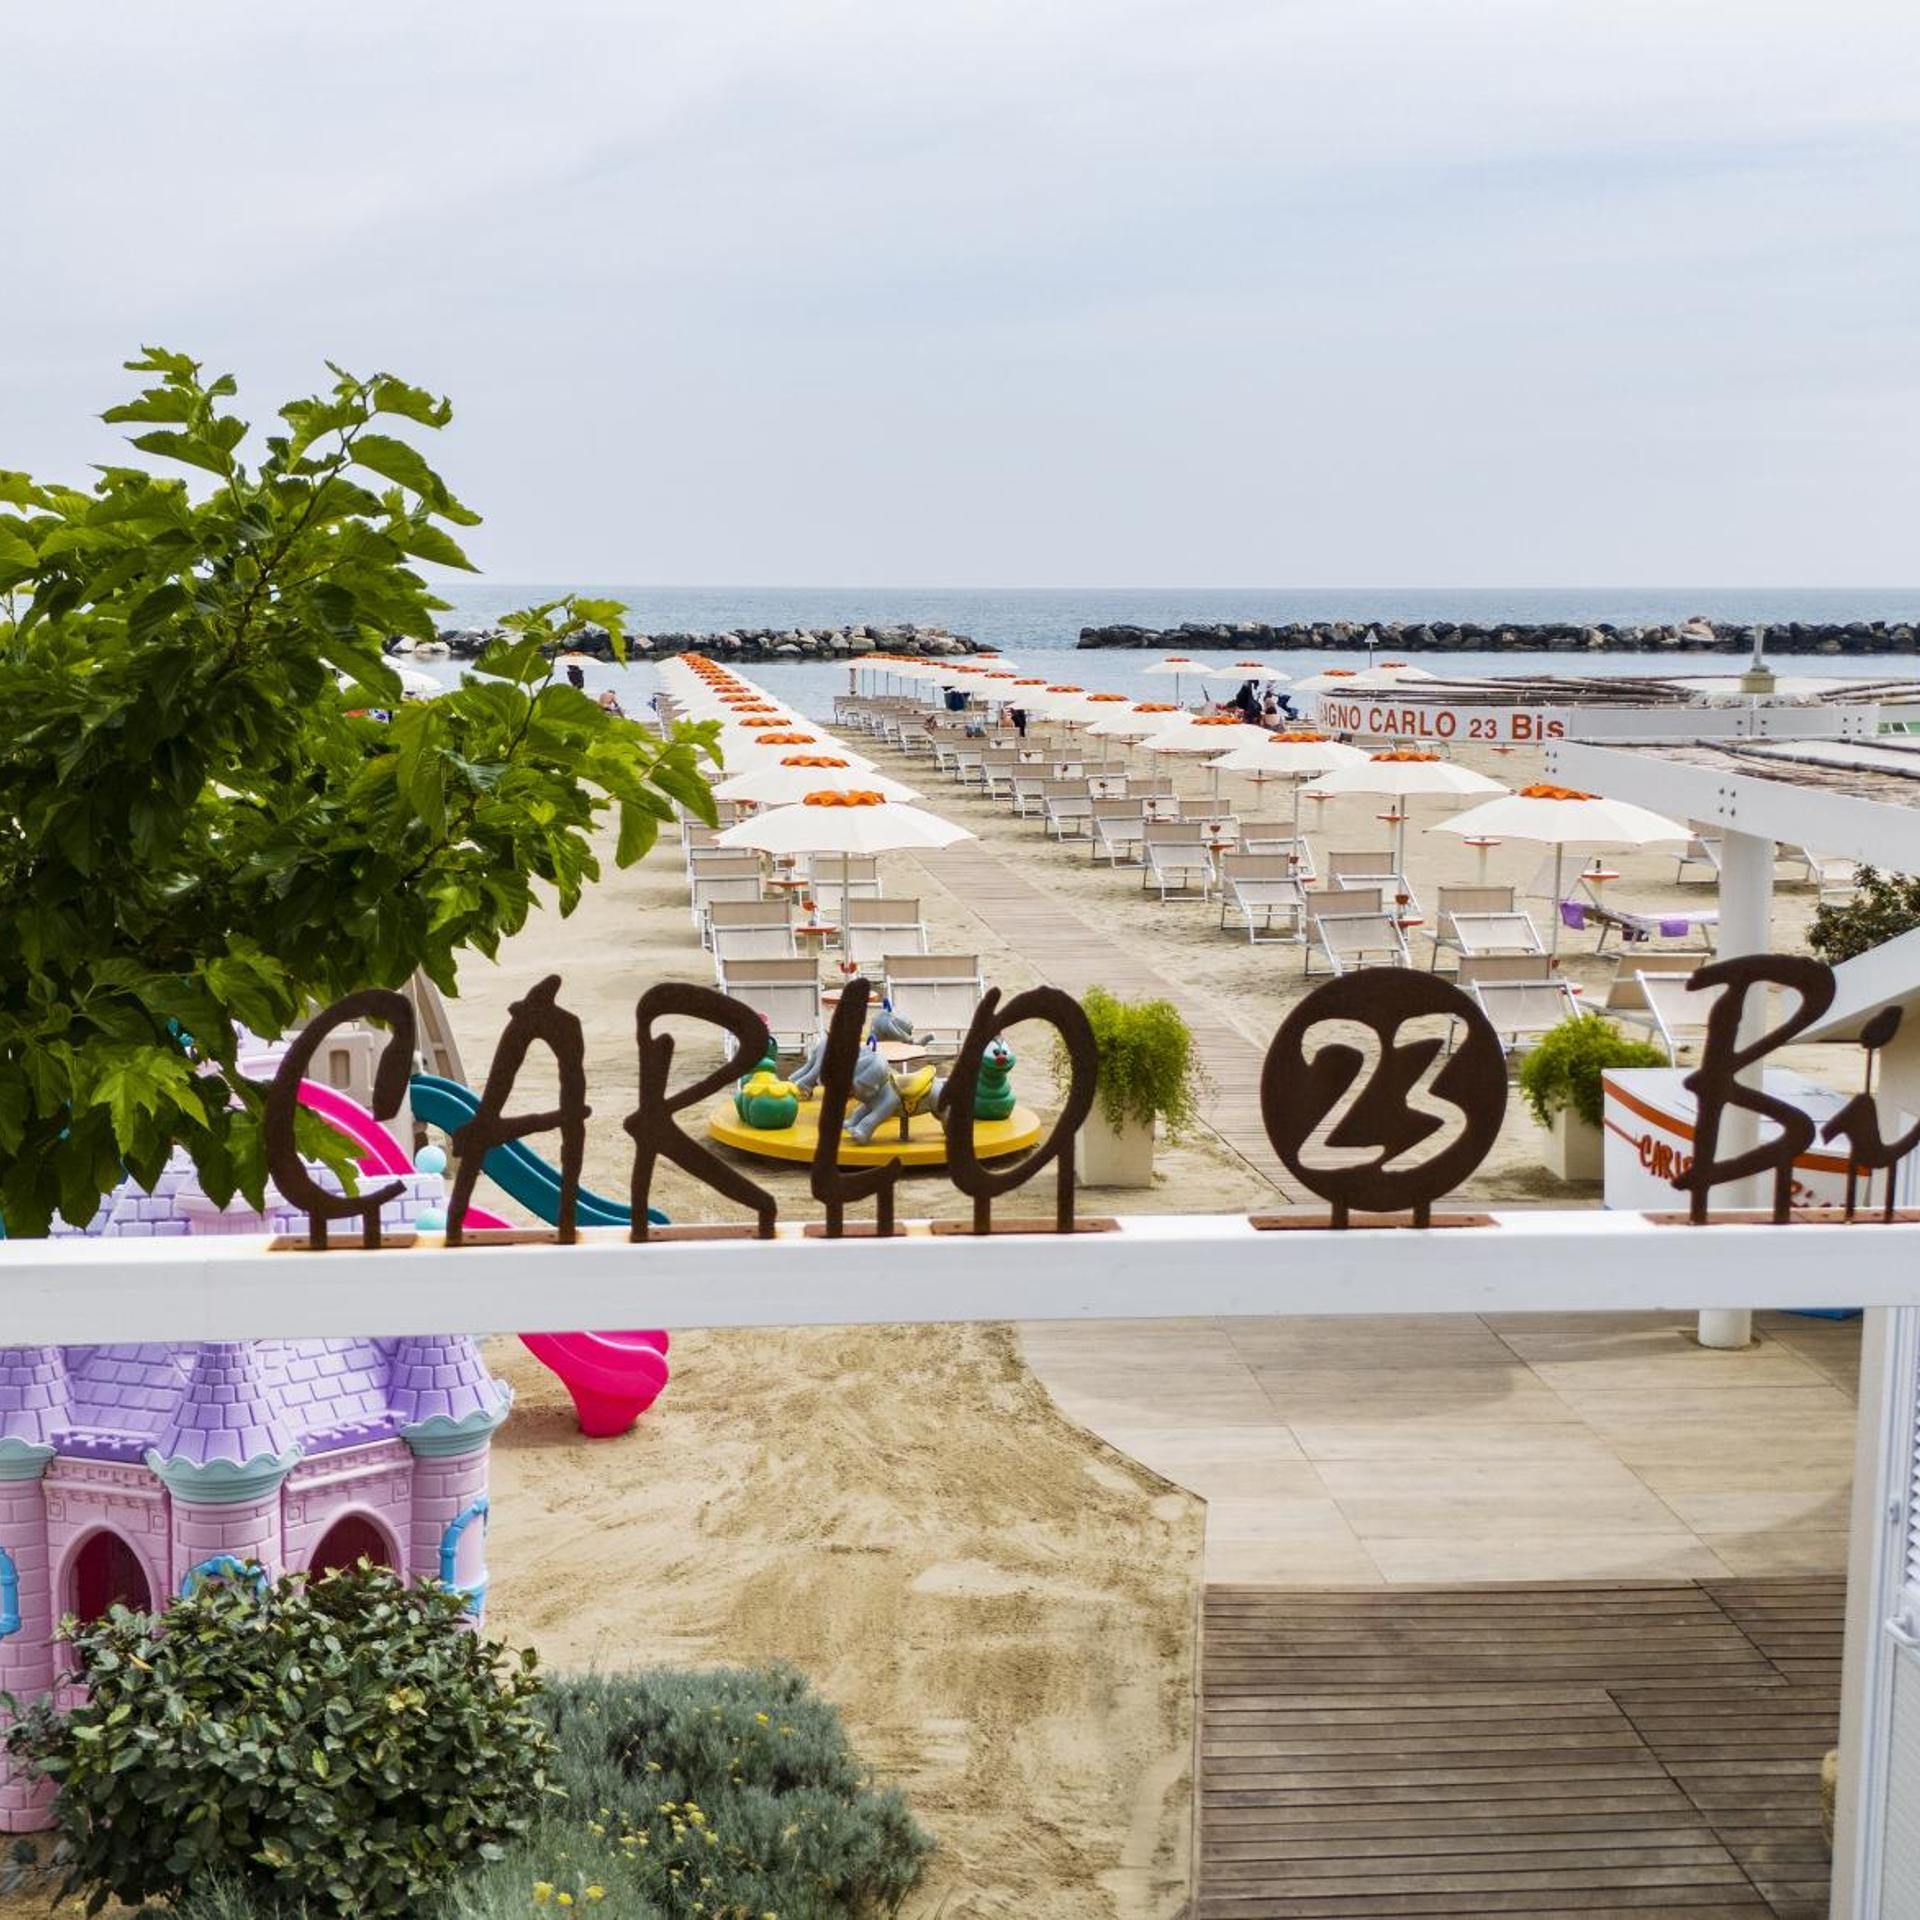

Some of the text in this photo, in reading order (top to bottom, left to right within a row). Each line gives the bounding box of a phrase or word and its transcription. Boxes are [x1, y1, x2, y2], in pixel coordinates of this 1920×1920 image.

[1369, 707, 1456, 738] CARLO
[1469, 718, 1497, 739] 23
[1511, 713, 1565, 740] Bis
[265, 974, 1098, 1245] CARLO
[1297, 1012, 1470, 1173] 23
